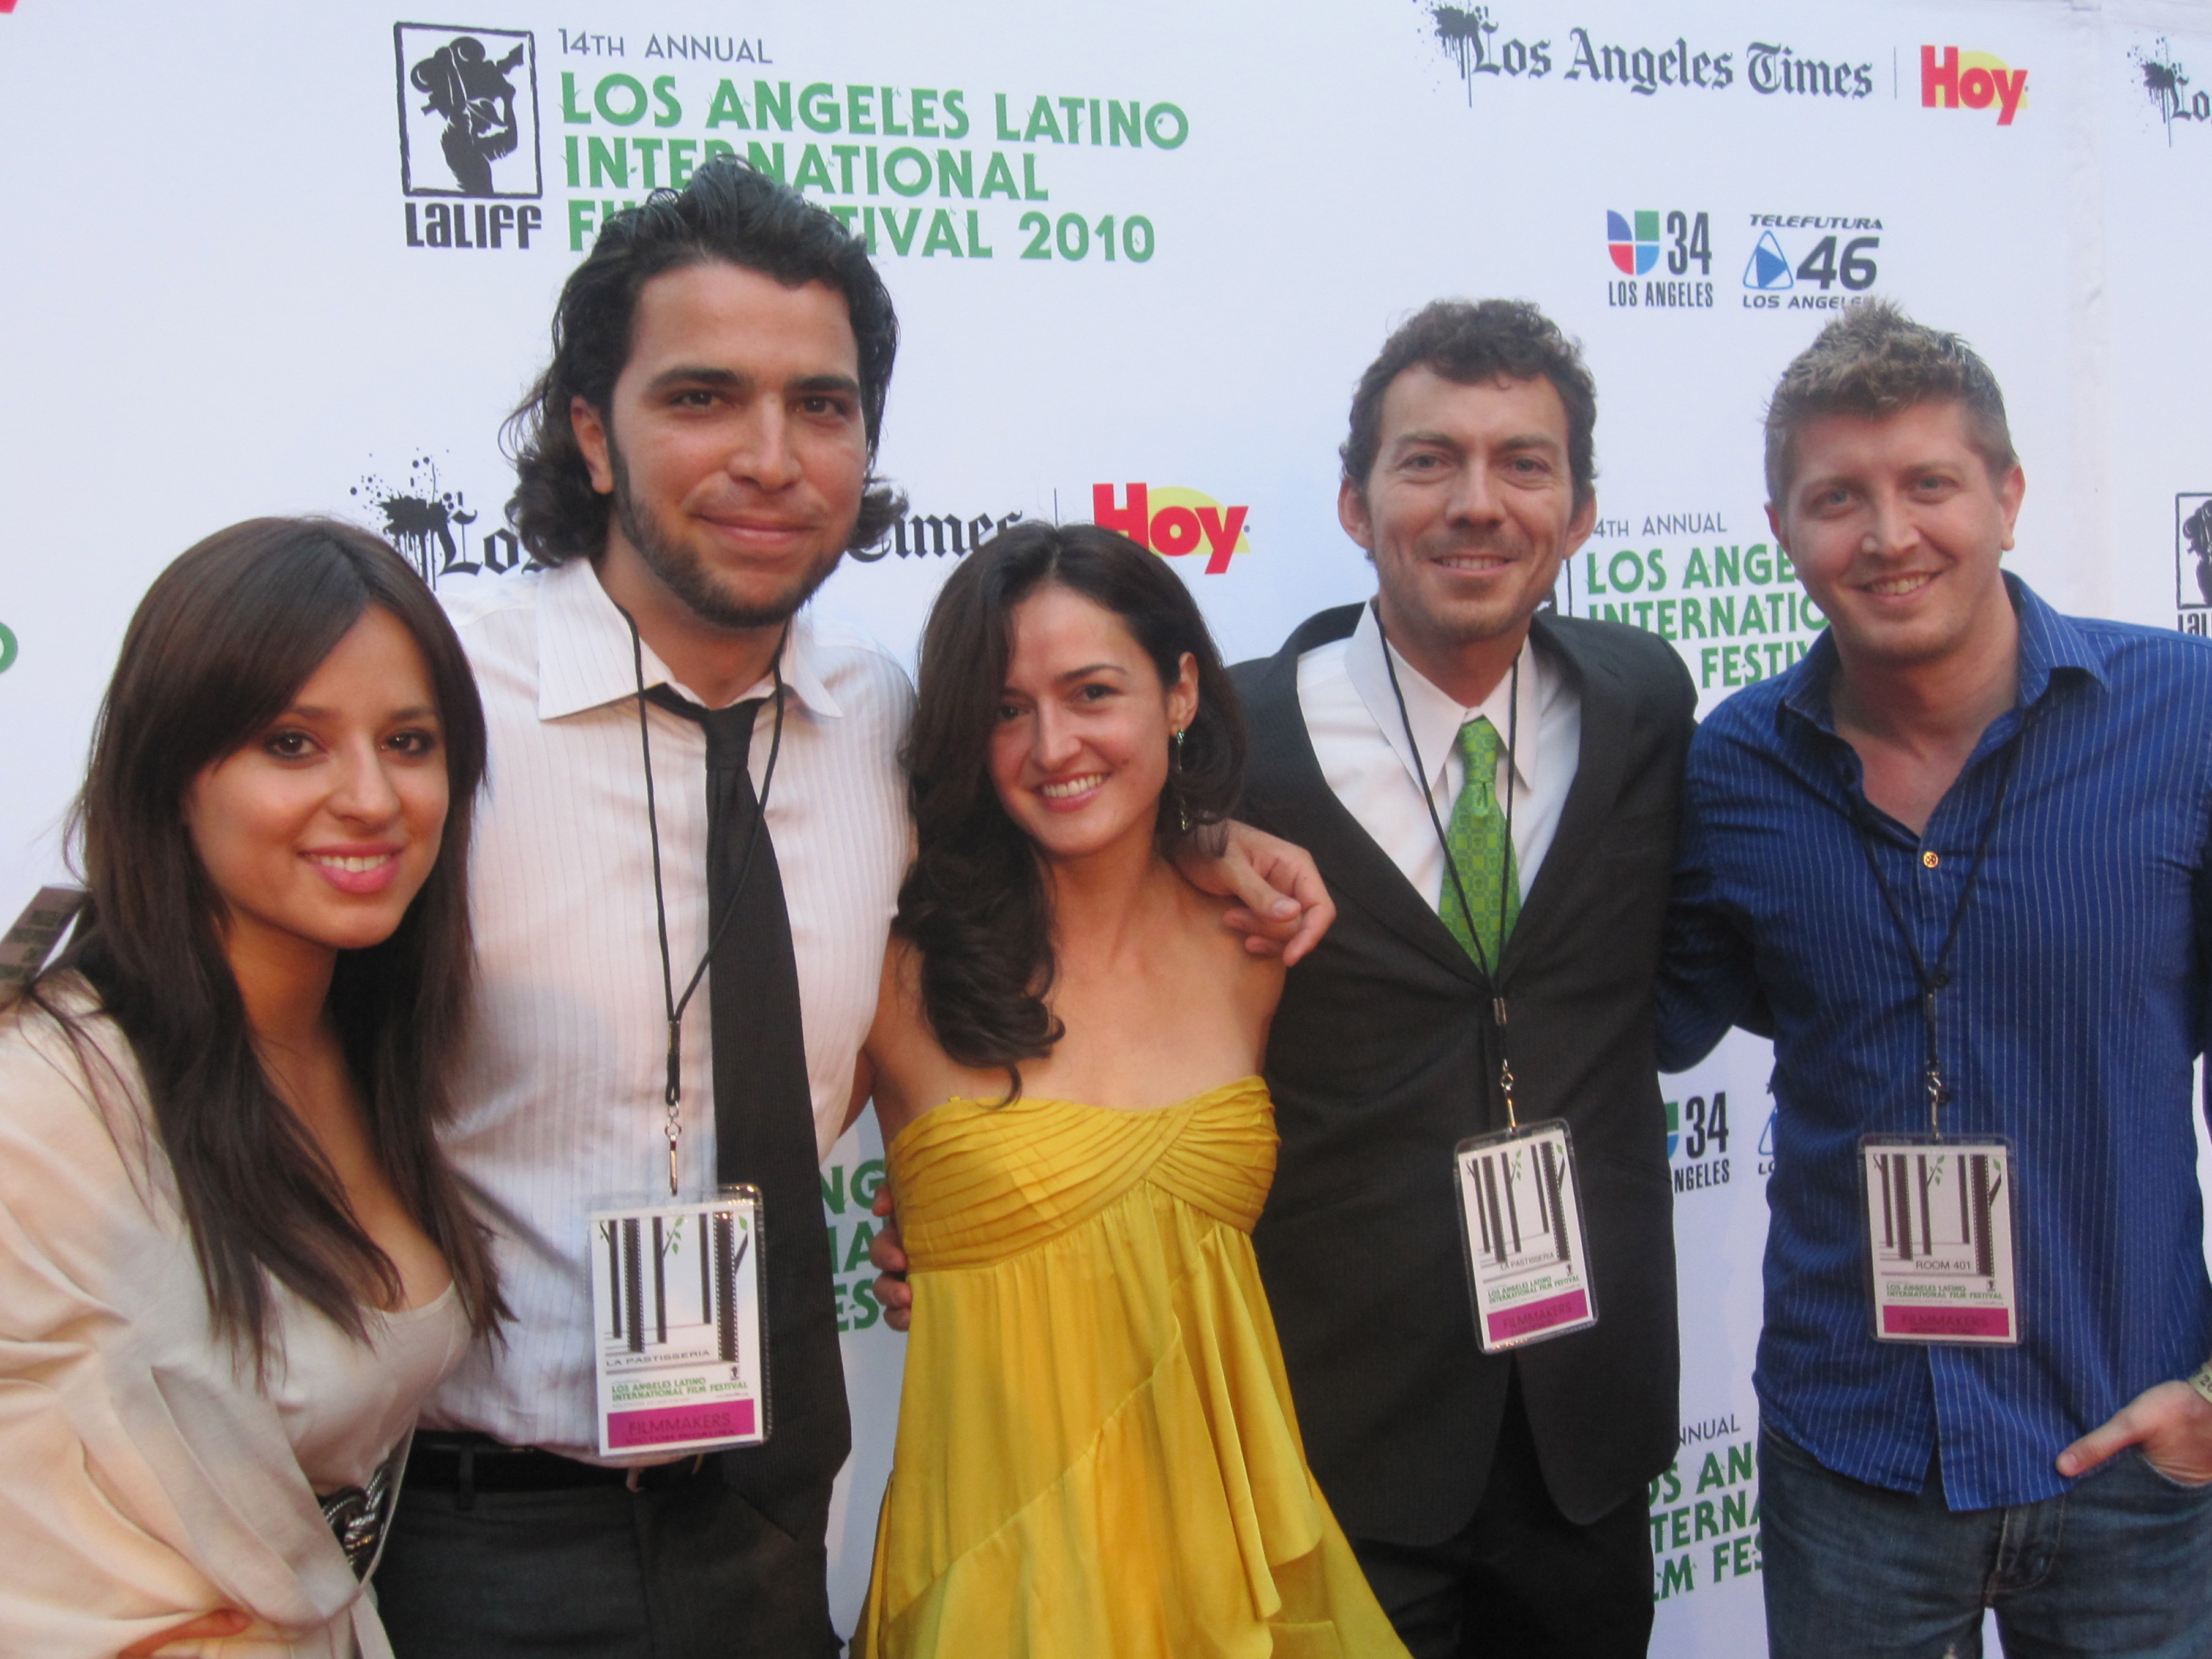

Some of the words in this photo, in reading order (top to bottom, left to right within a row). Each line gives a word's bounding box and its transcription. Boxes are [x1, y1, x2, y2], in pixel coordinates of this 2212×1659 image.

[558, 28, 625, 56] 14TH
[644, 33, 773, 64] ANNUAL
[1472, 21, 1552, 80] Los
[1563, 26, 1734, 96] Angeles
[1746, 40, 1873, 100] Times
[559, 71, 682, 128] LOS
[705, 78, 970, 140] ANGELES
[994, 92, 1189, 150] LATINO
[1920, 45, 2028, 126] Hoy
[2167, 64, 2212, 124] Lo
[1018, 210, 1156, 263] 2010
[1666, 210, 1713, 276] 34
[1750, 213, 1884, 230] TELEFUTURA
[1796, 235, 1881, 292] 46
[1609, 280, 1638, 307] LOS
[1645, 282, 1714, 307] ANGELES
[1743, 295, 1780, 308] LOS
[438, 510, 547, 577] Lo
[1093, 482, 1249, 575] Hoy
[1593, 517, 1629, 538] 4TH
[1642, 511, 1728, 537] ANNUAL
[1587, 548, 1668, 595] LOS
[1682, 543, 1800, 589] ANGE
[1685, 1091, 1729, 1160] 34
[1674, 1157, 1730, 1194] NGELES
[1915, 1260, 1951, 1270] ROOM
[1953, 1261, 1971, 1270] 401
[1502, 1301, 1573, 1330] FILMMAKERS
[628, 1412, 731, 1436] FILMMAKERS
